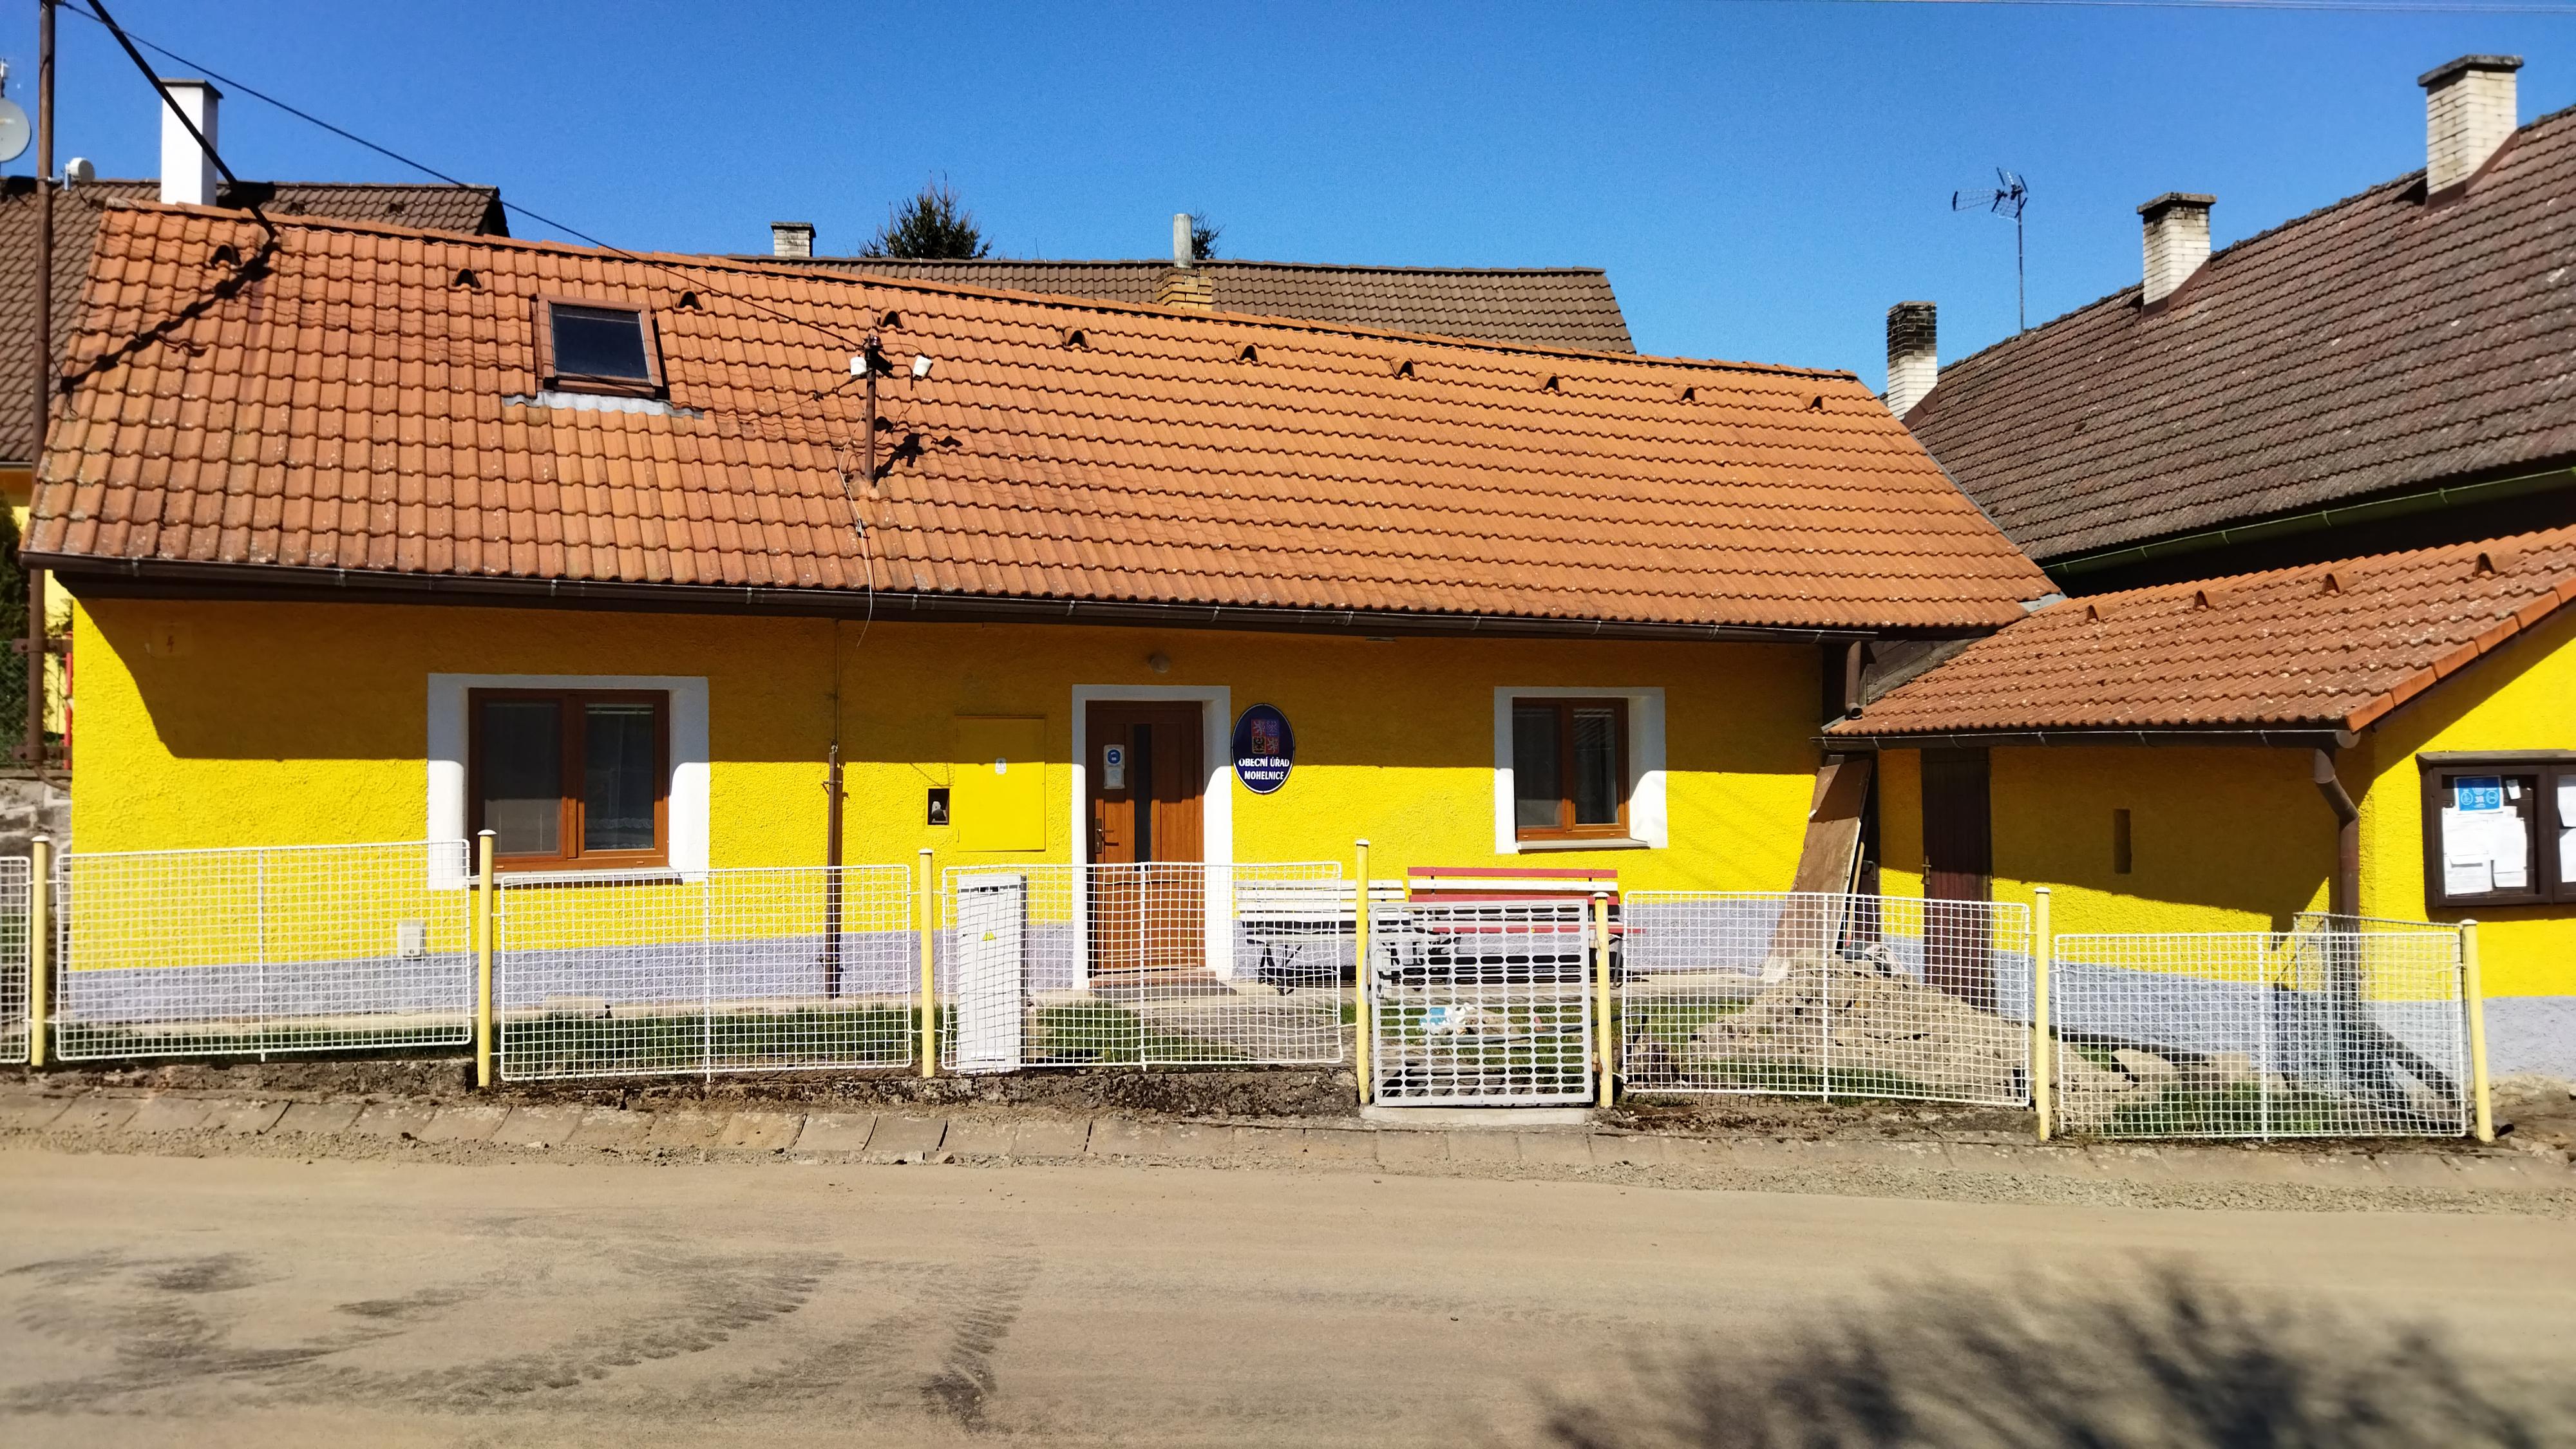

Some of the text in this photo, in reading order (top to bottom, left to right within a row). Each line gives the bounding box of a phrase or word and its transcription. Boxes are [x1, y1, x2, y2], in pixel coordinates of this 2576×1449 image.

[1238, 756, 1290, 767] OBECNÍ ÚŘAD
[1244, 770, 1284, 780] MOHELNICE
